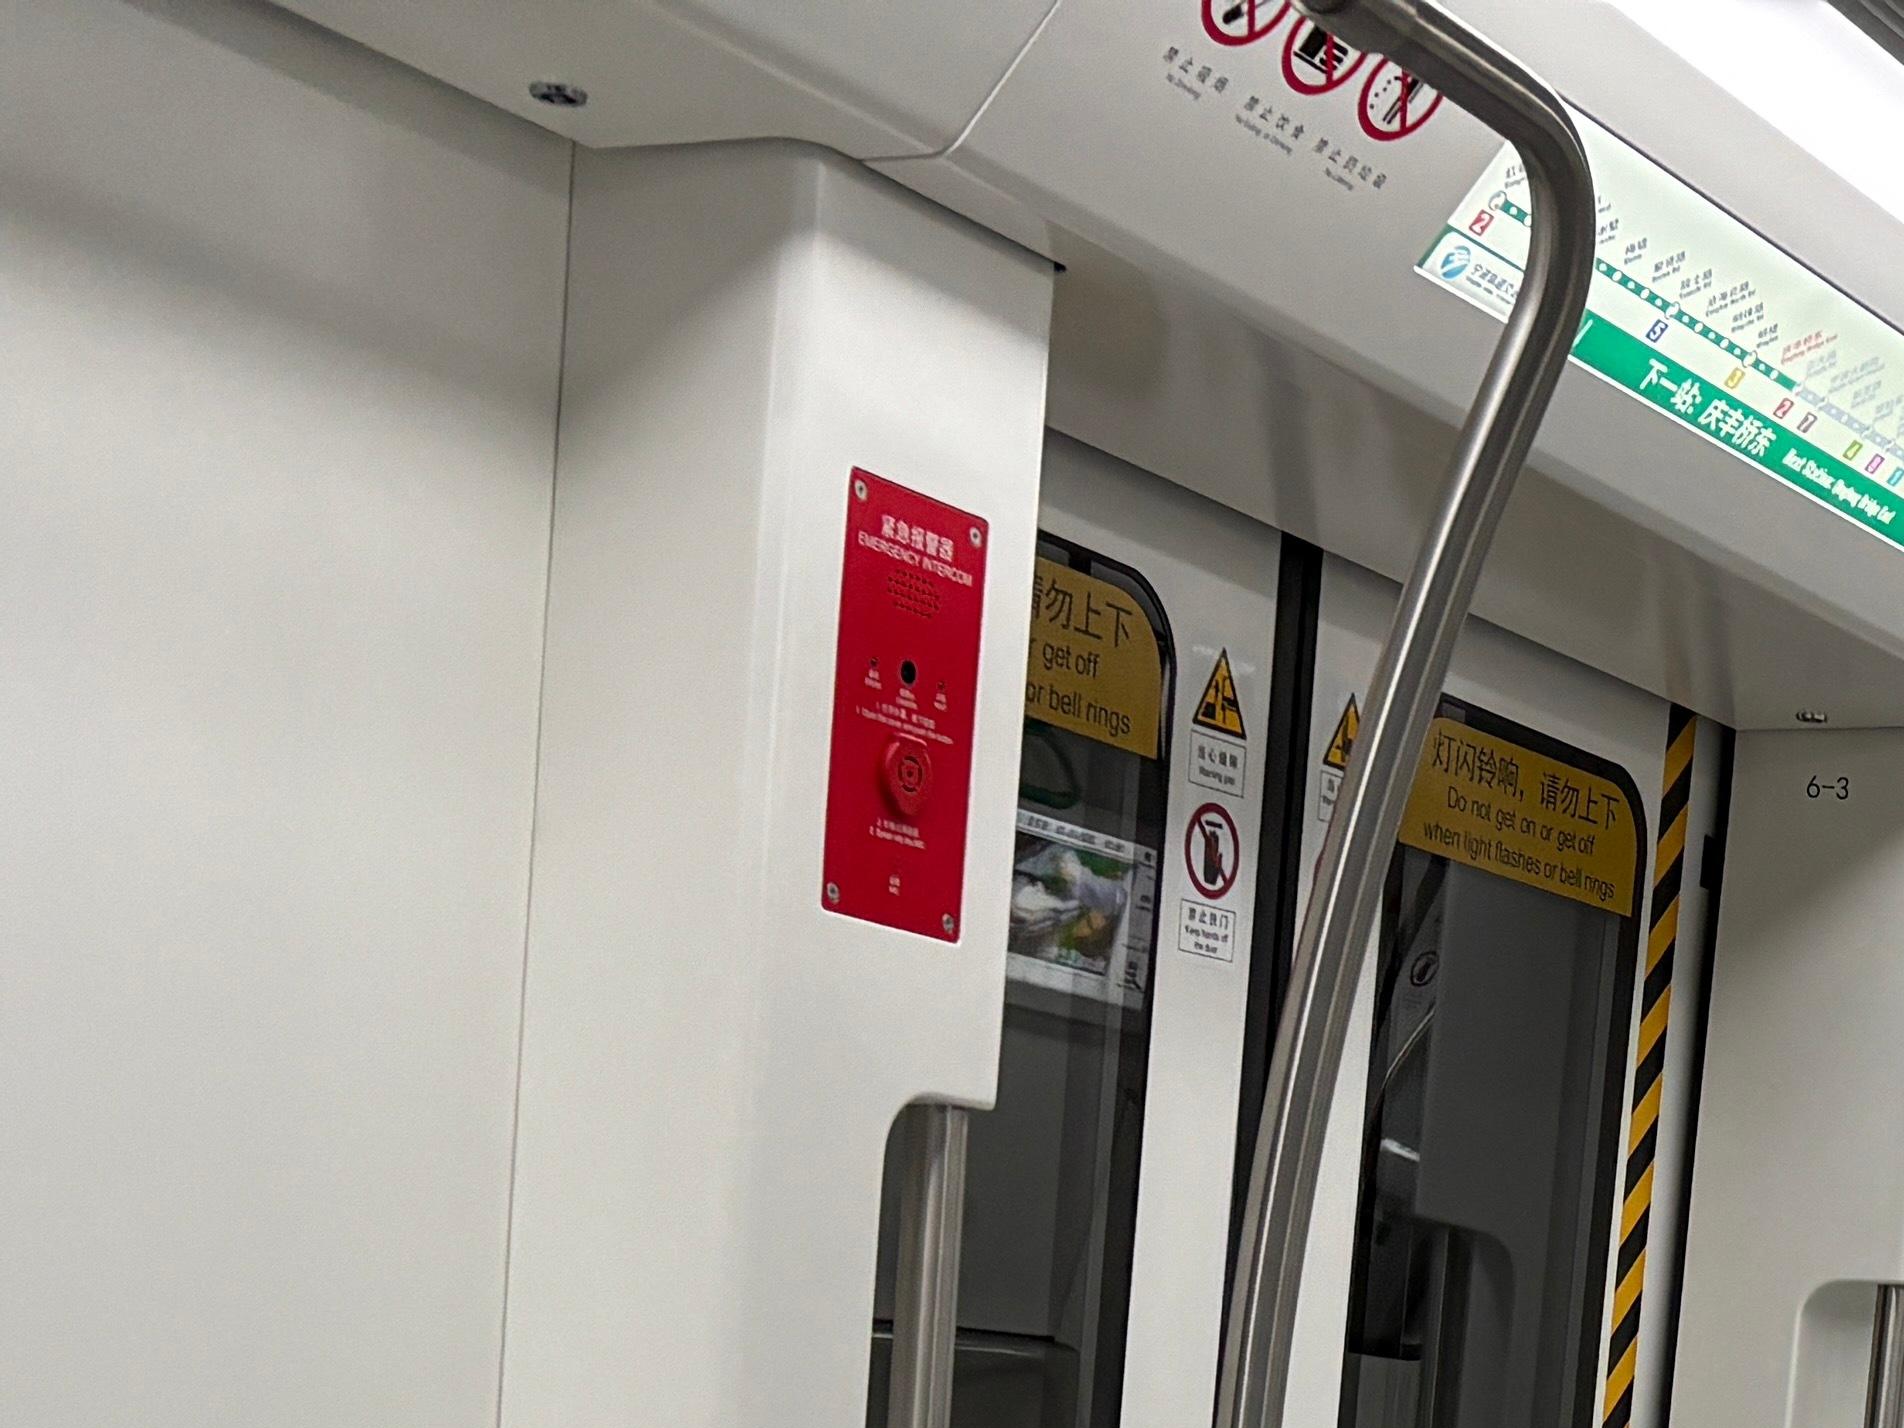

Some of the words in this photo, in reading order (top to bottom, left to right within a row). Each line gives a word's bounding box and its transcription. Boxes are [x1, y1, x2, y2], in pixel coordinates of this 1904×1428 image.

[1474, 212, 1490, 233] 2
[1650, 320, 1666, 342] 5
[1639, 358, 1703, 415] 下一站:
[1697, 397, 1777, 458] 庆丰桥东
[858, 529, 921, 565] EMERGENCY
[921, 553, 973, 587] INTERCOM
[881, 513, 954, 562] 紧急报警器
[1042, 643, 1073, 677] get
[1075, 651, 1099, 678] off
[1049, 684, 1082, 720] bell
[1085, 699, 1132, 737] rings
[1806, 774, 1851, 801] 6-3
[1447, 786, 1468, 811] Do
[1471, 800, 1492, 822] not
[1495, 808, 1517, 835] get
[1519, 817, 1537, 839] on
[1540, 825, 1555, 845] or
[1556, 827, 1578, 855] get
[1578, 834, 1597, 855] off
[1423, 821, 1461, 848] when
[1462, 828, 1493, 861] light
[1494, 842, 1542, 878] flashes
[1543, 862, 1558, 879] or
[1558, 860, 1583, 889] bell
[1583, 873, 1616, 902] rings
